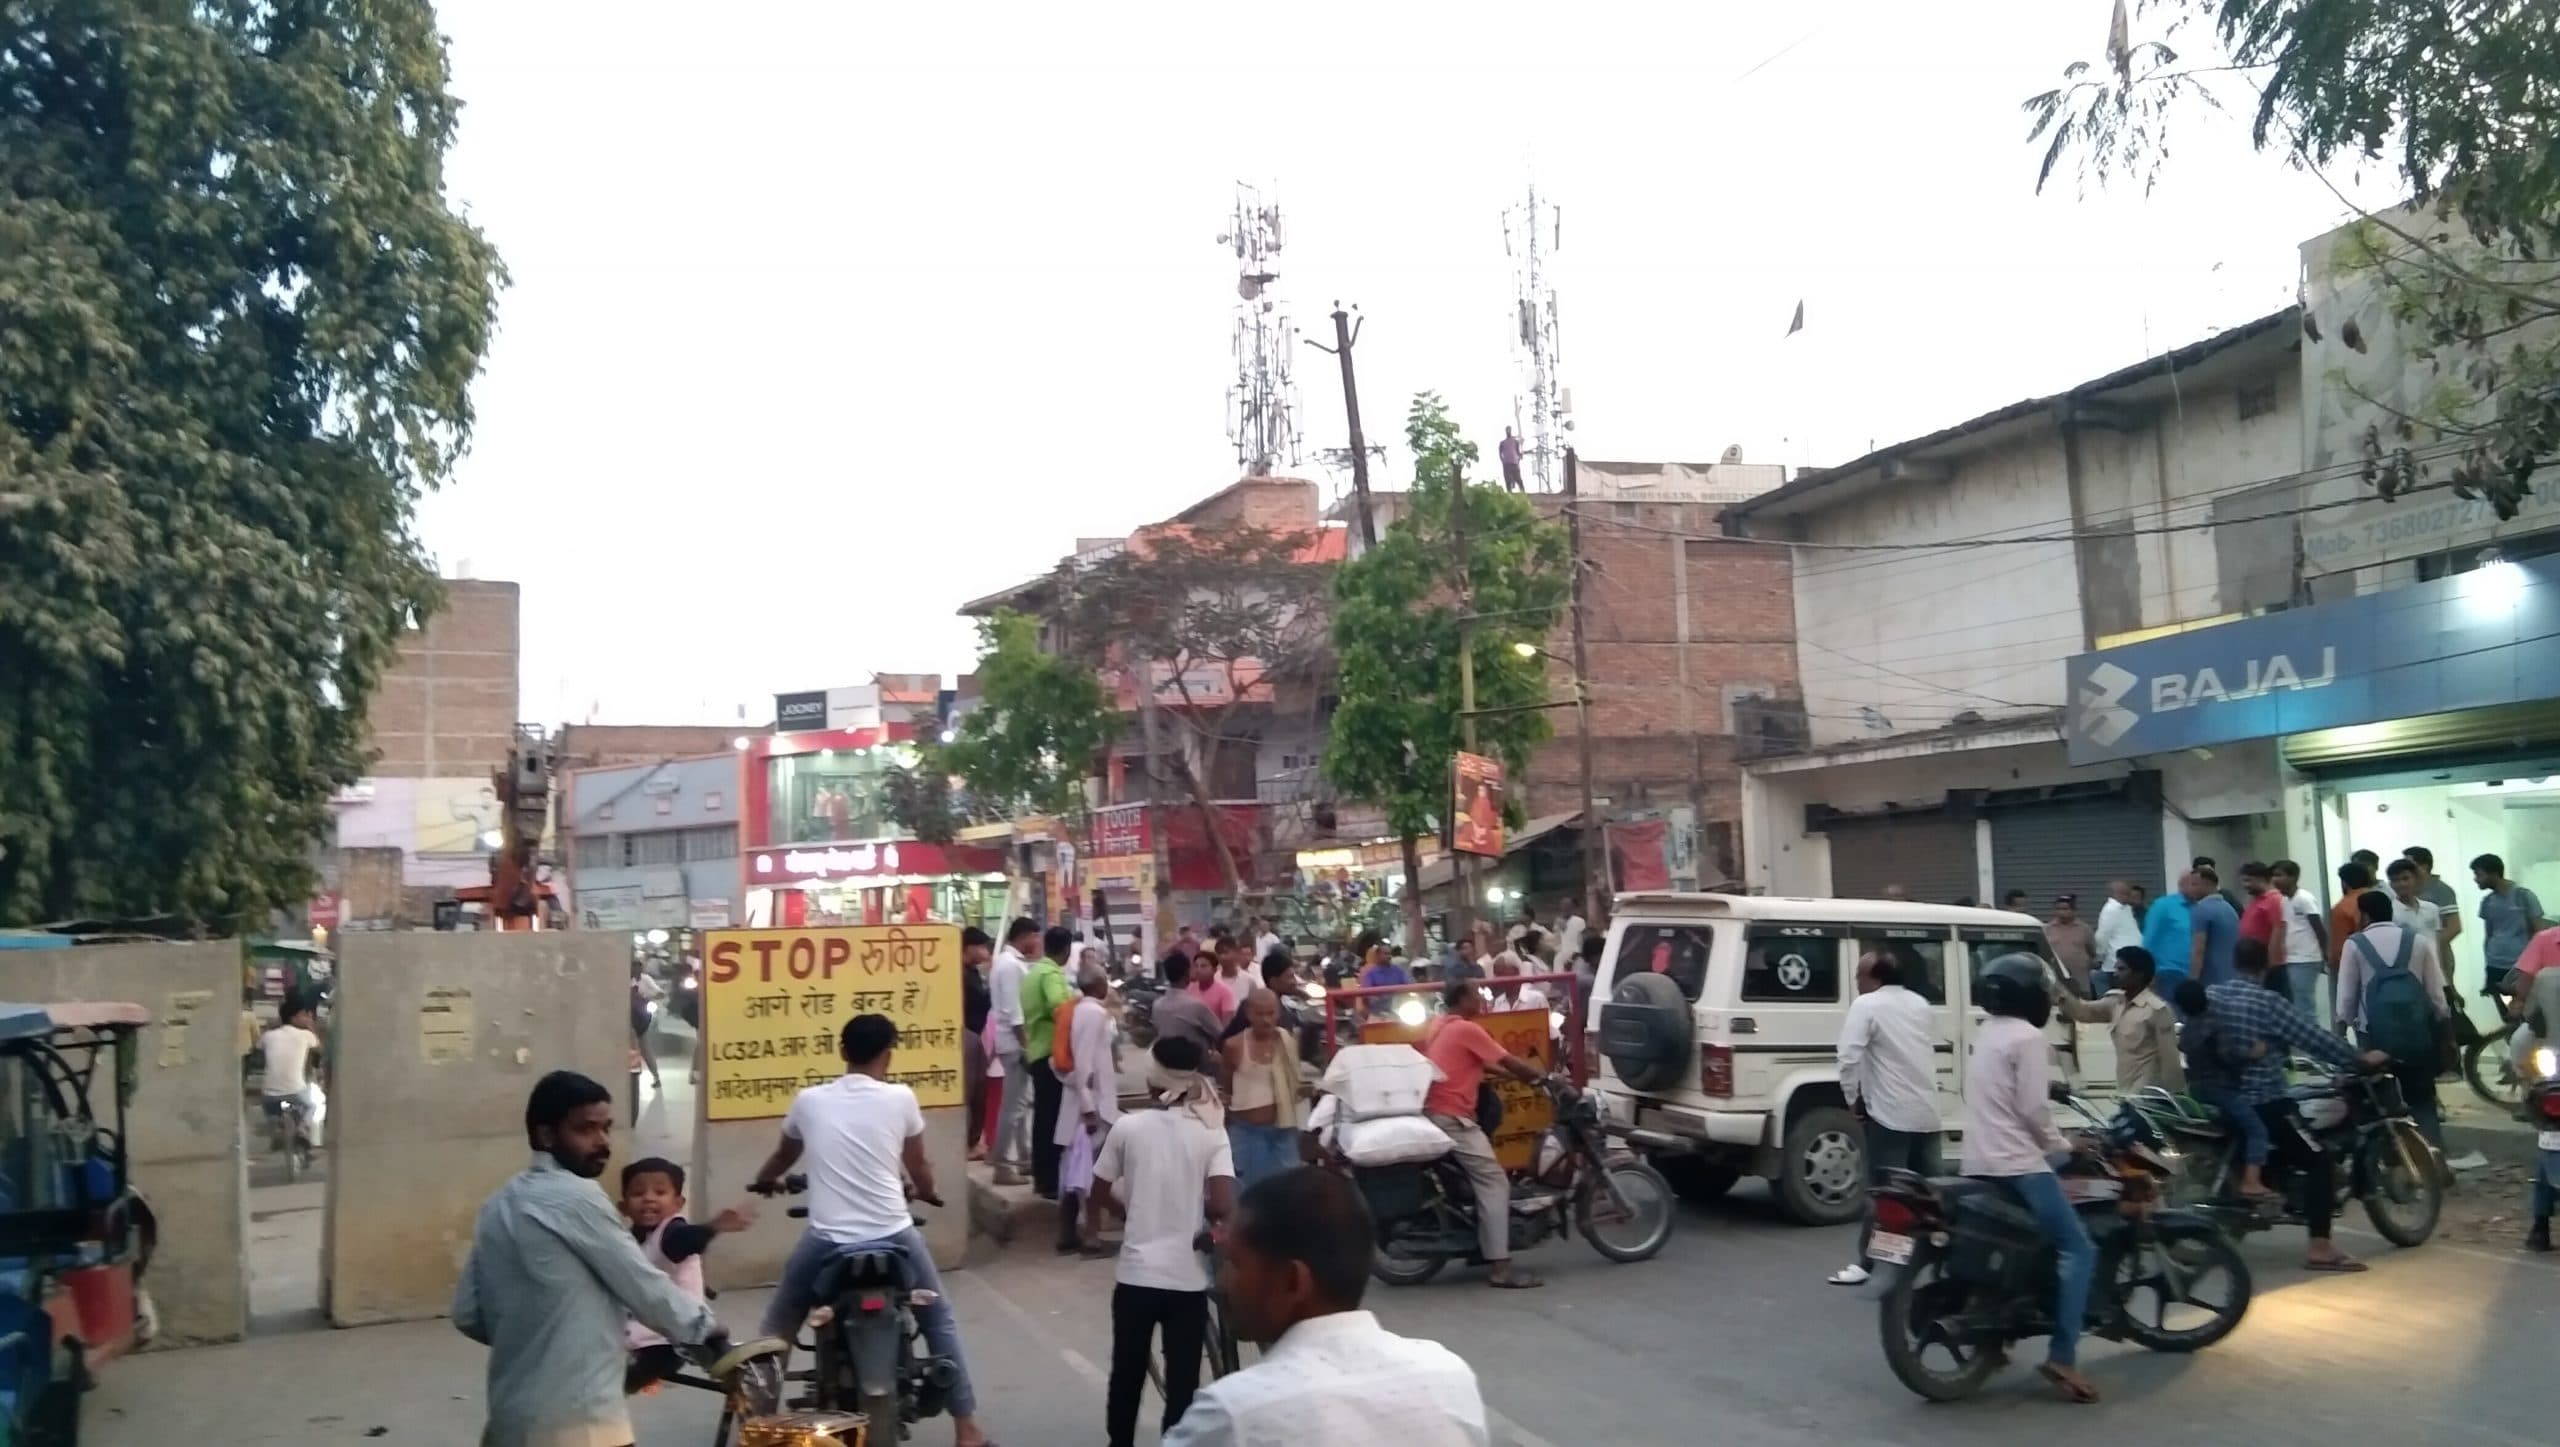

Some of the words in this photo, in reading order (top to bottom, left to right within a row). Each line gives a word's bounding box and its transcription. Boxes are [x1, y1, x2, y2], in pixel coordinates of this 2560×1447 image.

[2151, 645, 2336, 713] BAJAJ
[1780, 927, 1824, 937] 4X4
[709, 937, 851, 983] STOP
[743, 988, 792, 1018] आगे
[712, 1039, 776, 1061] LC32A
